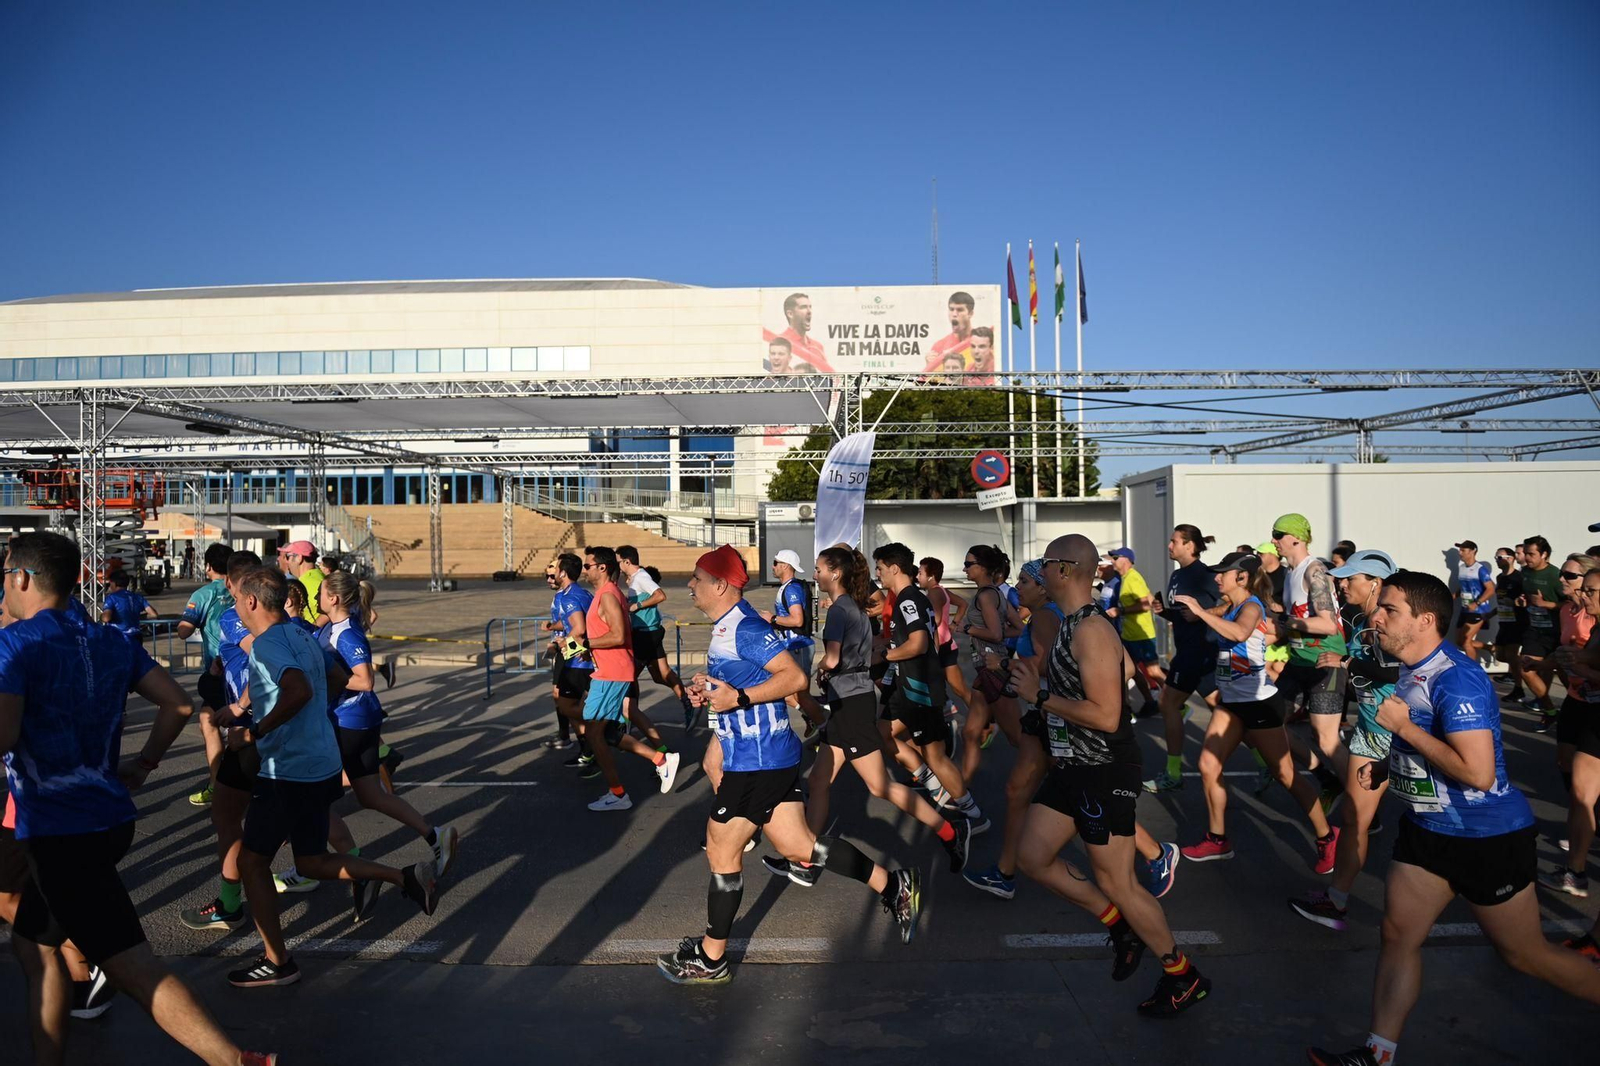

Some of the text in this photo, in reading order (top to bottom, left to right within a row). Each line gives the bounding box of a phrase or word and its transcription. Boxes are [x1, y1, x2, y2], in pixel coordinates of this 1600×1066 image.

[828, 323, 930, 339] VIVE LA DAVIS
[837, 339, 920, 356] EN MÁLAGA
[863, 360, 886, 368] FINAL
